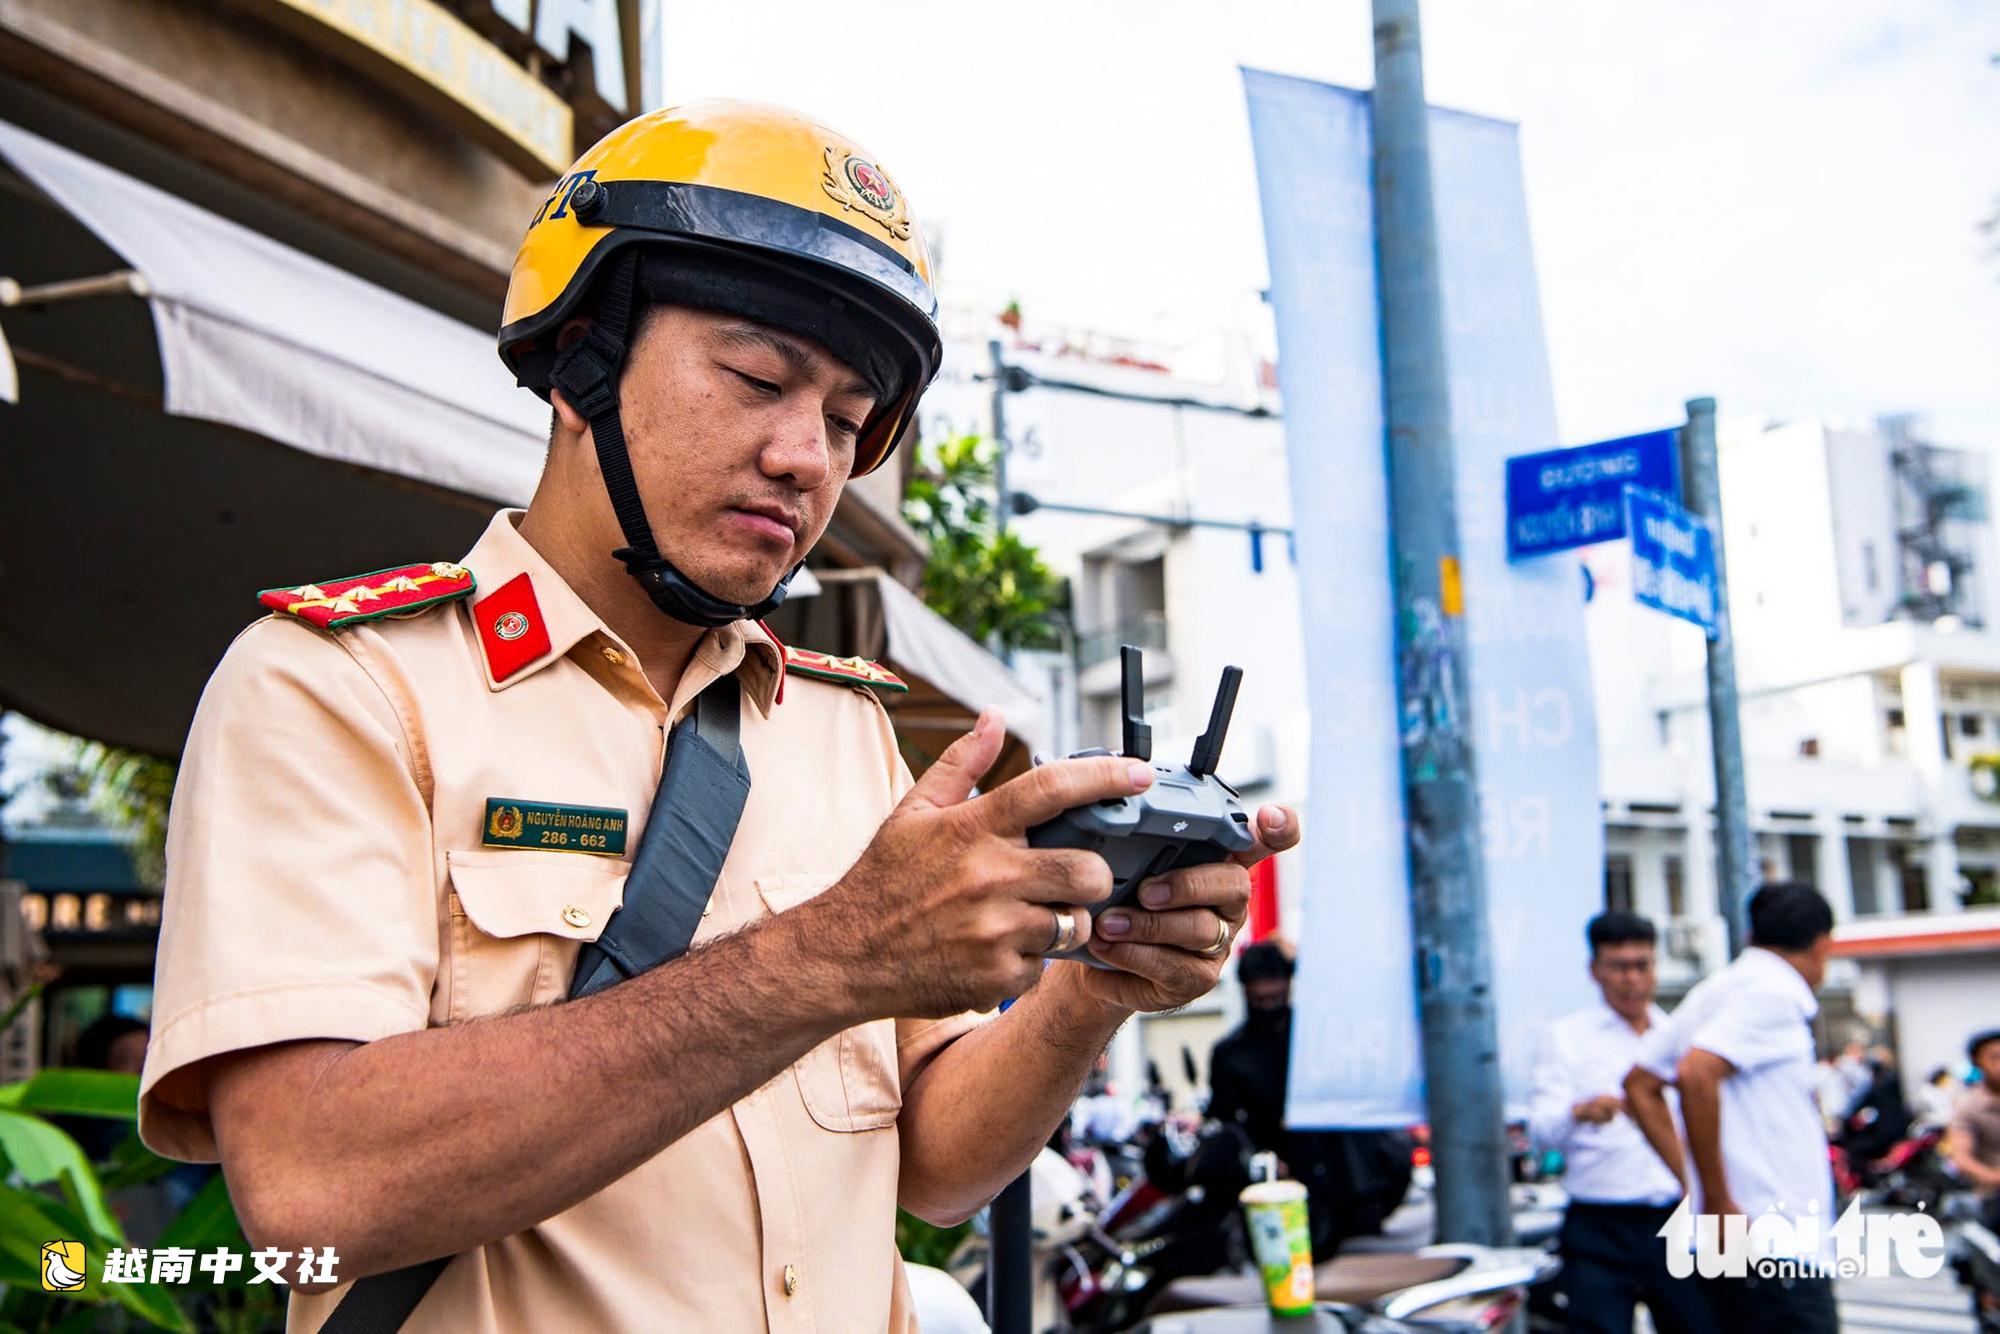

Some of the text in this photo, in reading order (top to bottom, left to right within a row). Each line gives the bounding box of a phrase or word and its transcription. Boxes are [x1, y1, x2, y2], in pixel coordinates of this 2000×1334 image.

[568, 813, 602, 831] HOÀNG
[602, 818, 624, 832] ANH
[541, 830, 568, 845] 286
[580, 833, 607, 848] 662
